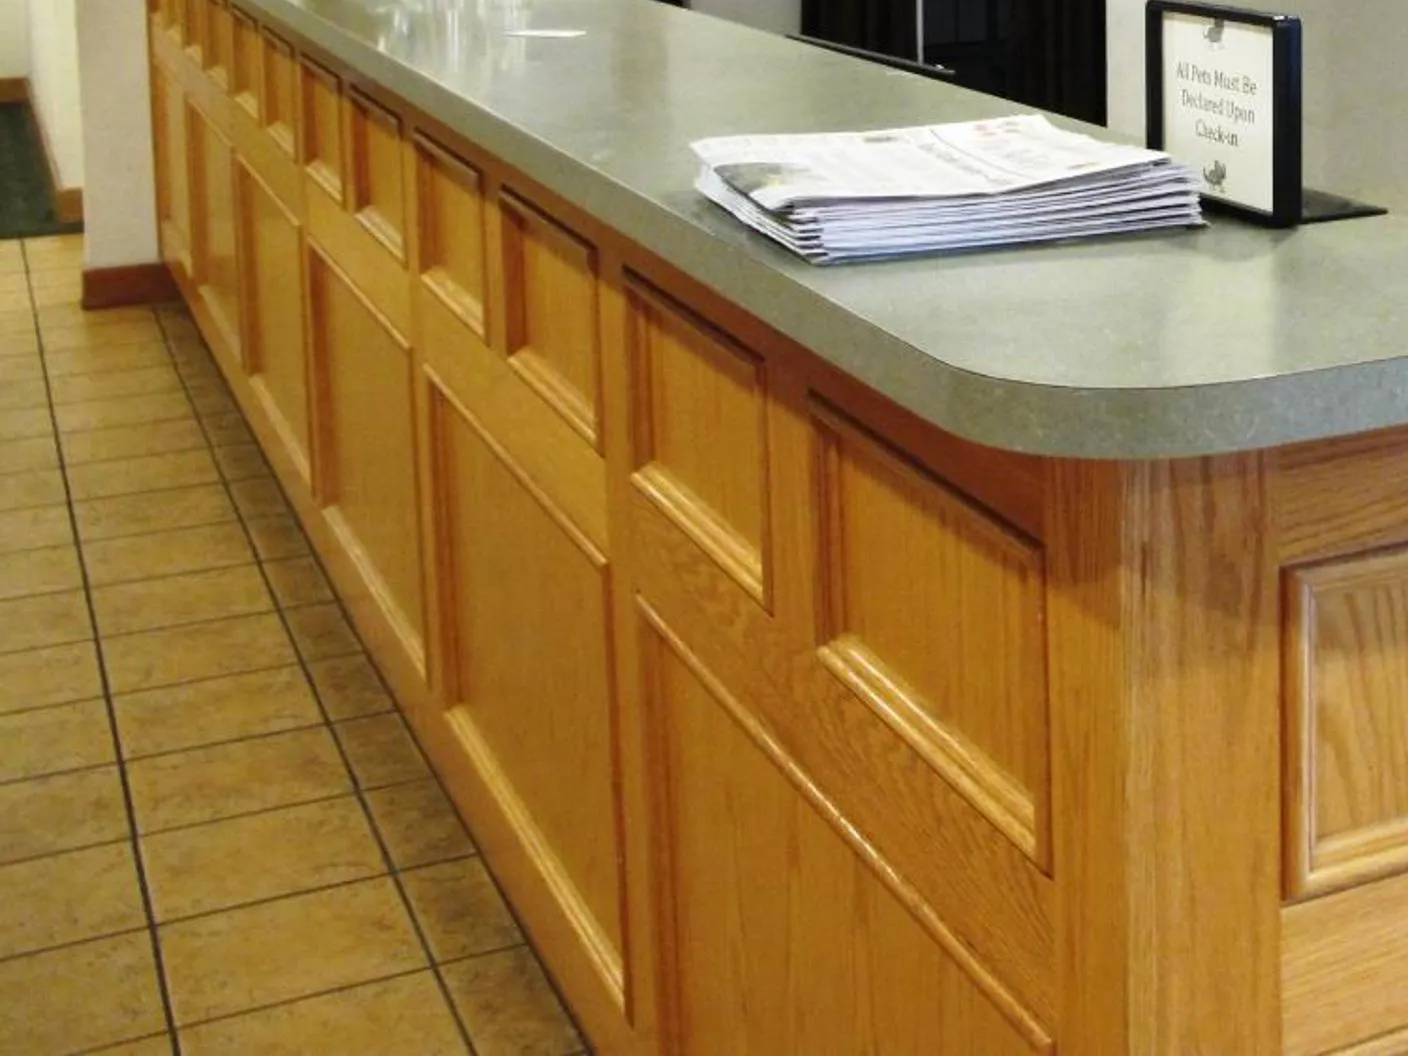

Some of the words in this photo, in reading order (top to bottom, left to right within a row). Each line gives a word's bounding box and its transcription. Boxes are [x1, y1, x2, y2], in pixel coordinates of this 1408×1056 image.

[1191, 64, 1211, 85] Pets
[1214, 69, 1240, 92] Must
[1242, 75, 1257, 96] Be
[1182, 89, 1224, 116] Declared
[1226, 100, 1256, 125] Upon
